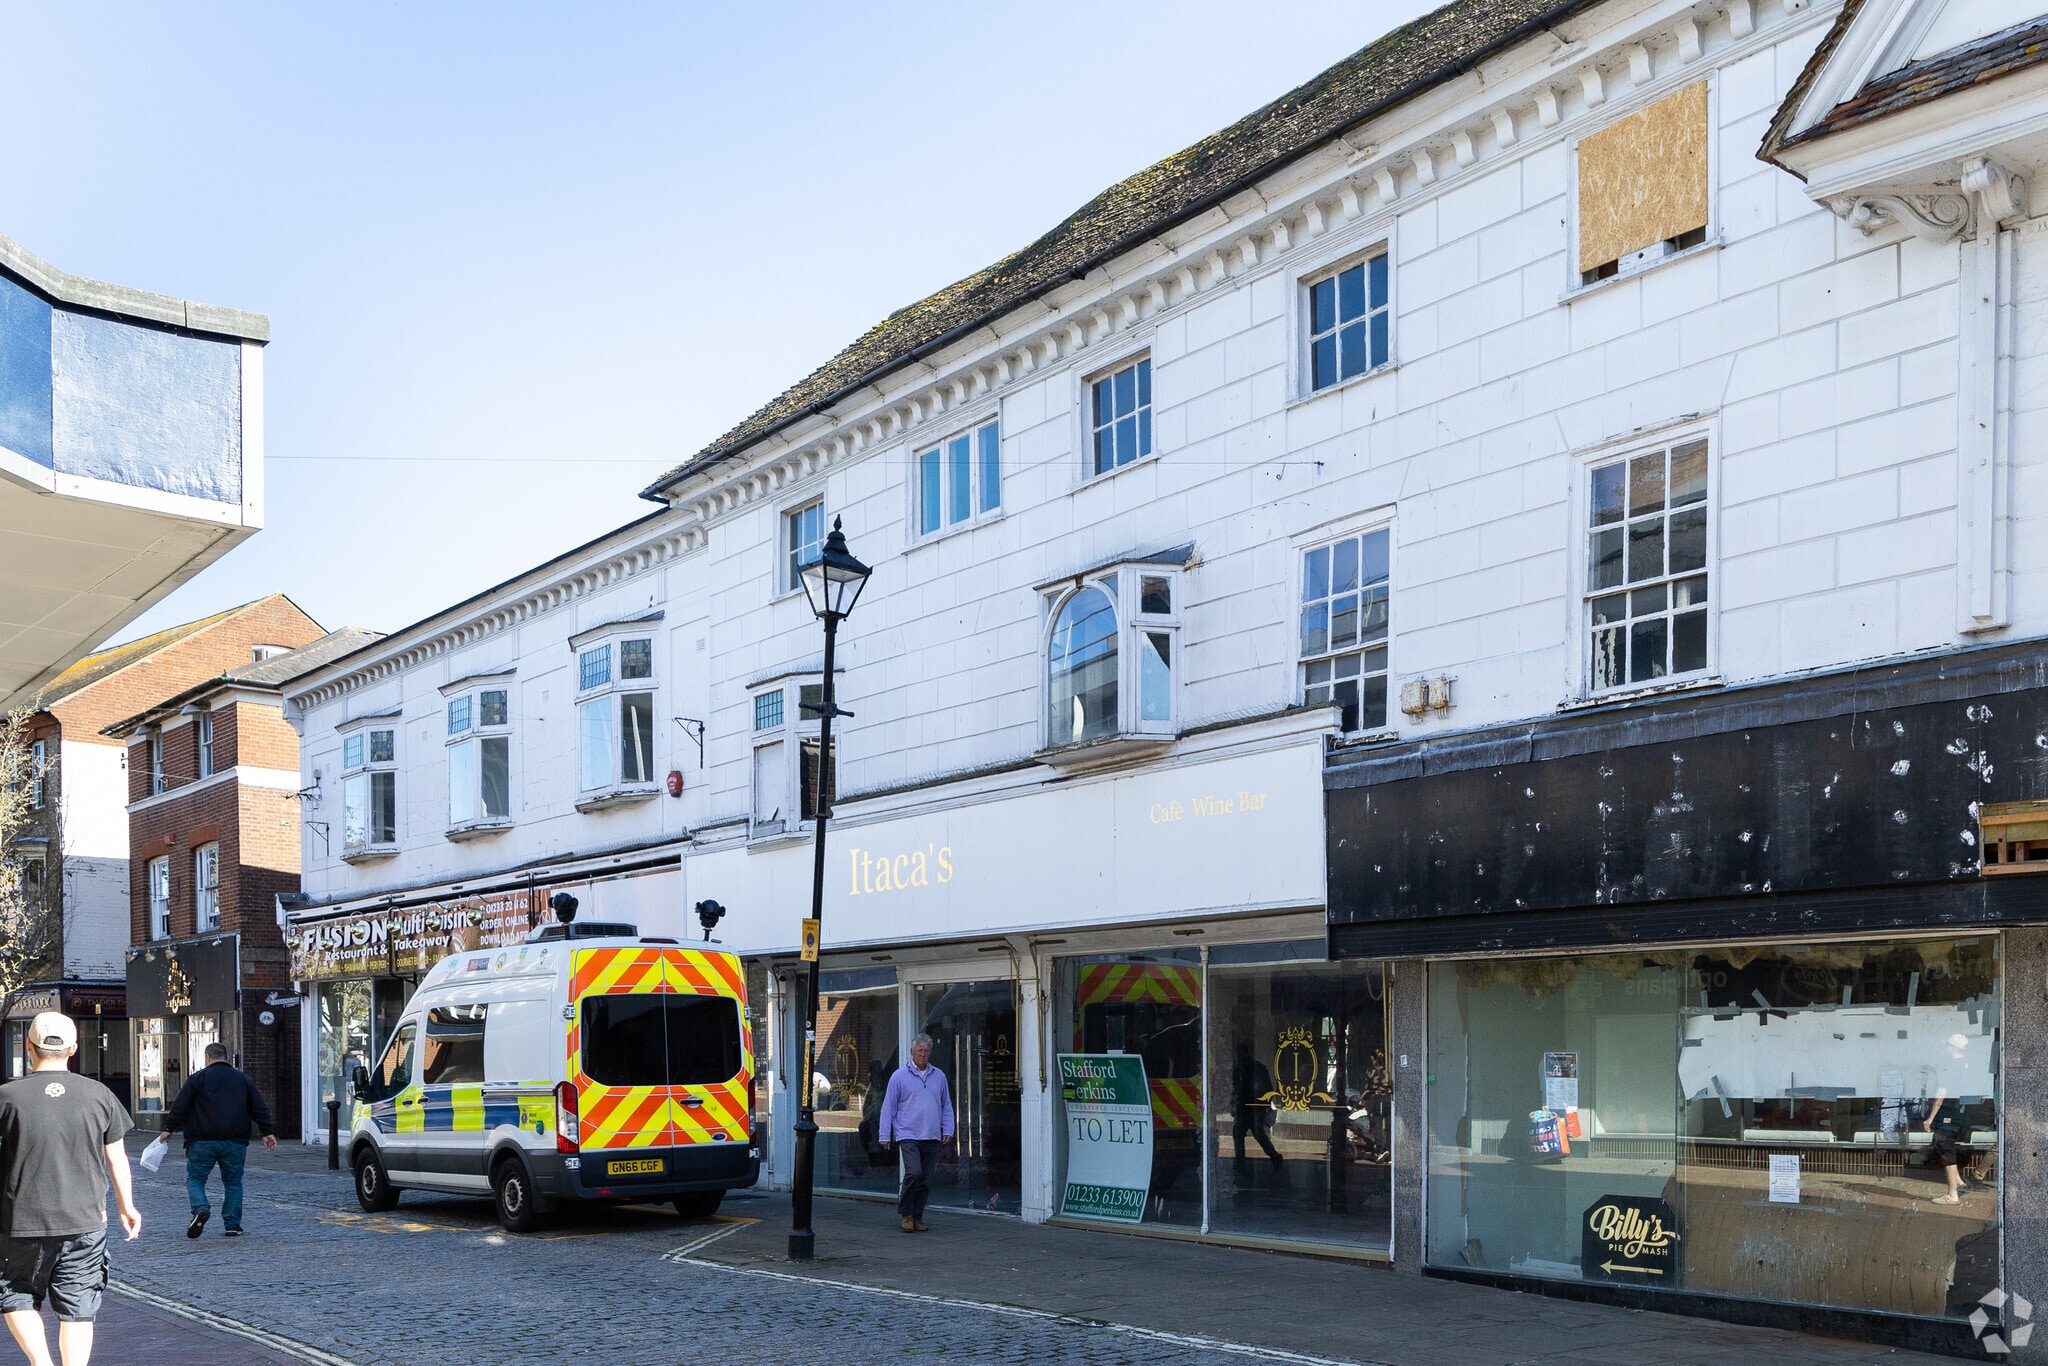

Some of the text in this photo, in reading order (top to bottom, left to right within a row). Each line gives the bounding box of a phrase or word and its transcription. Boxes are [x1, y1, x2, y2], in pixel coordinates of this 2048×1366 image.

[1192, 795, 1233, 818] Wine
[1239, 791, 1268, 812] Bar
[849, 843, 953, 896] Itaca's
[520, 898, 528, 909] 62
[480, 914, 529, 931] ORDER ONLINE
[302, 917, 388, 953] FUSION
[480, 932, 514, 946] DOWNLOAD
[325, 935, 450, 961] Restaurant & Takeaway
[1063, 1060, 1117, 1078] Stafford
[1065, 1081, 1117, 1100] erkins
[1072, 1117, 1148, 1144] TO LET
[612, 1160, 659, 1173] GN66 CGF
[1068, 1184, 1144, 1207] 01233 613900
[1065, 1203, 1140, 1218] www.staffordperkins.co.uk
[1589, 1205, 1681, 1258] Billy's
[1608, 1243, 1668, 1256] PIE & MASH
